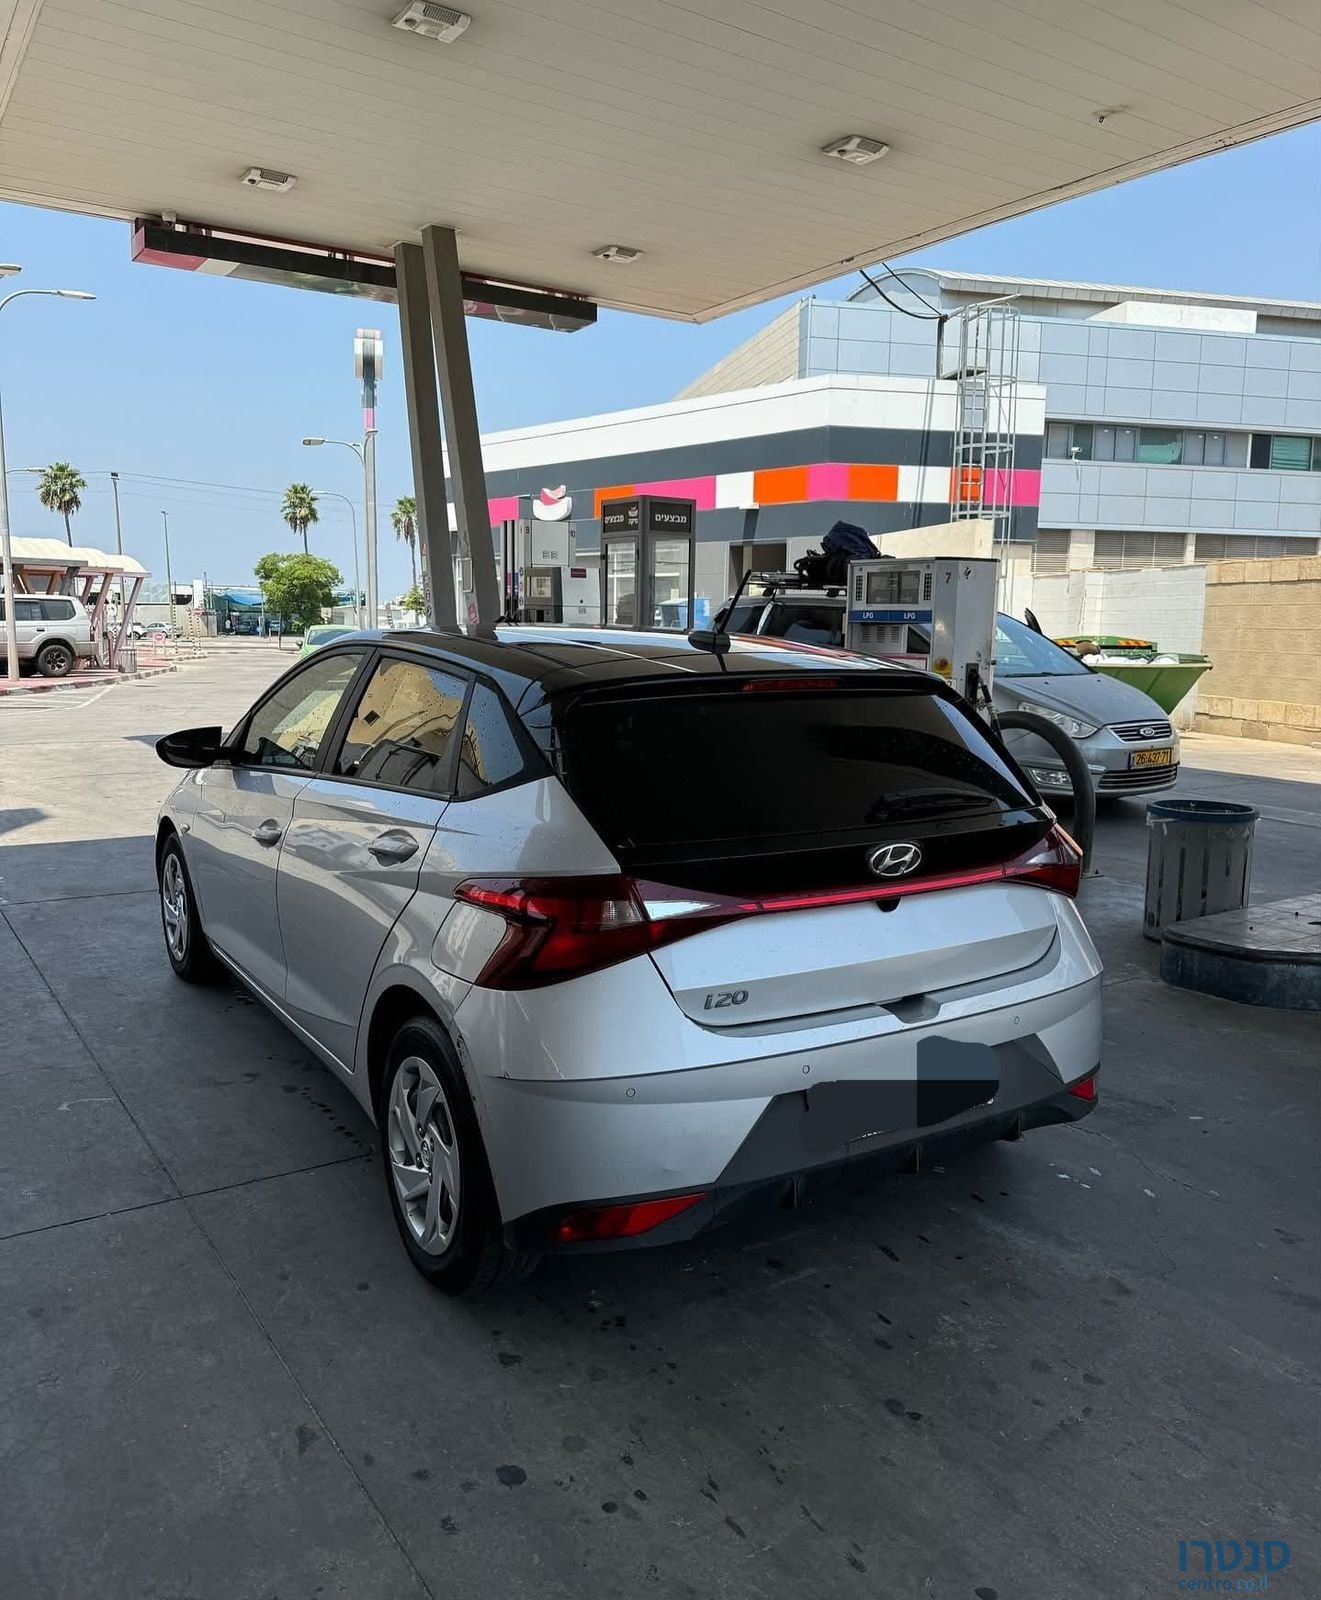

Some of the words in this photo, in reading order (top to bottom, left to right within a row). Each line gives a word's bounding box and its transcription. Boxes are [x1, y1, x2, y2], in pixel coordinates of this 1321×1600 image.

[655, 513, 687, 523] מבצעים
[945, 572, 952, 584] 7
[903, 612, 916, 620] LPG
